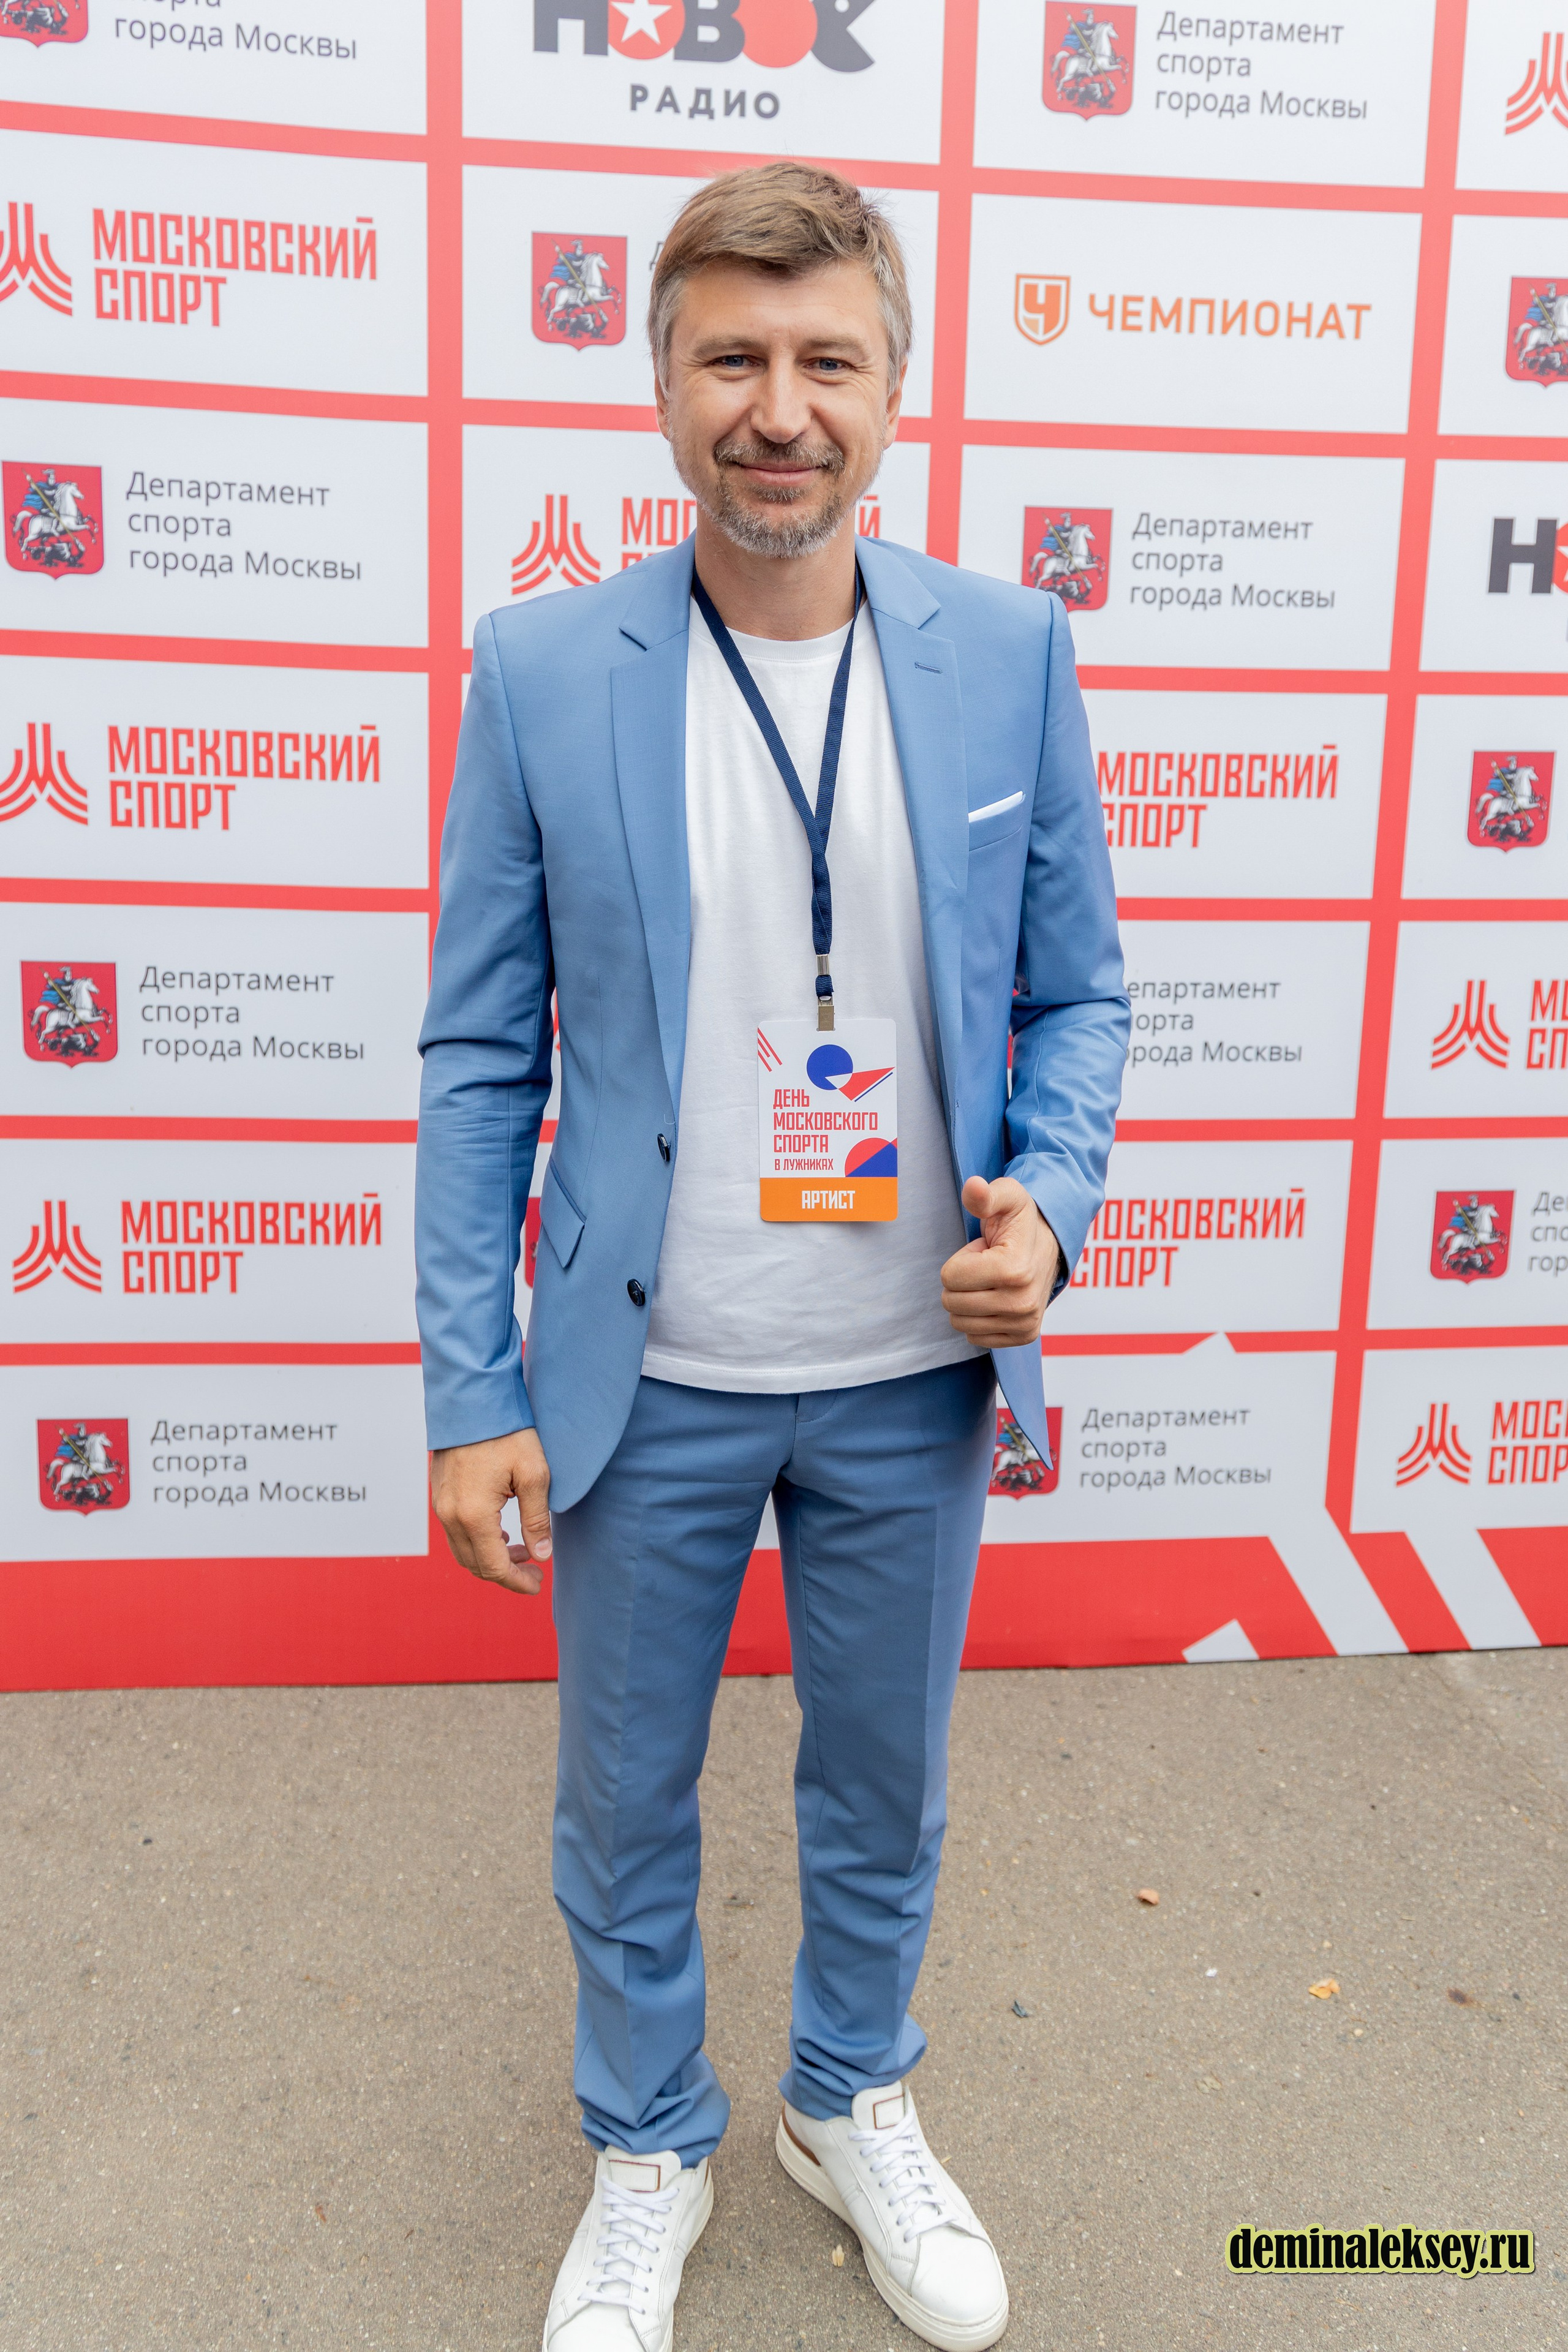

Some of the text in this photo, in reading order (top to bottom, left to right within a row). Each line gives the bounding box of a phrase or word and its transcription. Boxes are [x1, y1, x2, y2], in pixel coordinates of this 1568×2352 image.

[116, 18, 356, 59] города Москвы
[1156, 10, 1344, 46] Департамент
[1157, 53, 1251, 82] спорта
[630, 84, 780, 120] РАДИО
[1156, 90, 1367, 119] города Москвы
[93, 208, 377, 280] МОСКОВСКИЙ
[94, 268, 227, 326] СПОРТ
[1089, 293, 1371, 339] ЧЕМПИОНАТ
[126, 471, 330, 507] Департамент
[128, 513, 230, 541] спорта
[1132, 512, 1313, 543] Департамент
[130, 550, 360, 579] города Москвы
[1132, 552, 1223, 578] спорта
[1131, 584, 1335, 611] города Москвы
[108, 725, 379, 782] МОСКОВСКИЙ
[1098, 744, 1339, 799] МОСКОВСКИЙ
[110, 780, 236, 830] СПОРТ
[139, 966, 334, 996] Департамент
[1128, 981, 1280, 1005] епартамент
[141, 1005, 239, 1029] спорта
[1131, 1013, 1193, 1036] орта
[143, 1036, 363, 1062] города Москвы
[1126, 1041, 1302, 1068] рода Москвы
[773, 1089, 809, 1109] ДЕНЬ
[774, 1112, 878, 1130] МОСКОВСКОГО
[774, 1134, 828, 1153] СПОРТА
[775, 1158, 833, 1170] В ЛУЖНИКАХ
[802, 1190, 855, 1209] АРТИСТ
[1532, 1191, 1568, 1216] Де
[122, 1193, 381, 1246] МОСКОВСКИЙ
[123, 1251, 243, 1293] СПОРТ
[151, 1420, 337, 1446] Департамент
[1080, 1408, 1250, 1433] Департамент
[1492, 1401, 1568, 1439] МОС
[153, 1455, 247, 1477] спорта
[1081, 1441, 1166, 1463] спорта
[1080, 1465, 1271, 1493] города Москвы
[154, 1481, 366, 1508] города Москвы
